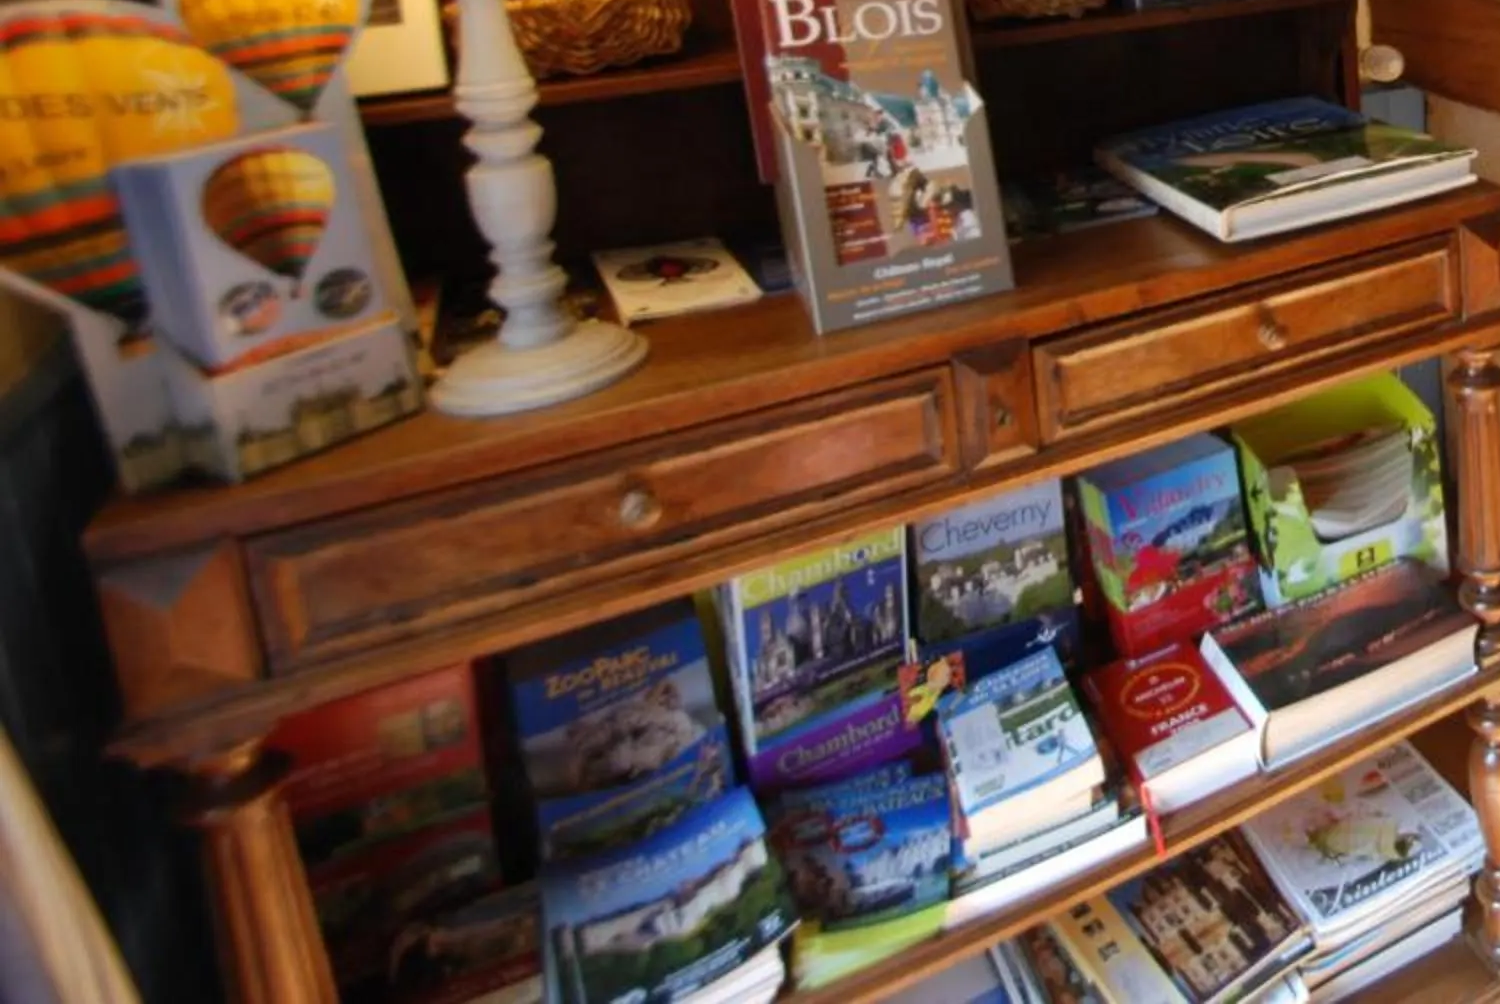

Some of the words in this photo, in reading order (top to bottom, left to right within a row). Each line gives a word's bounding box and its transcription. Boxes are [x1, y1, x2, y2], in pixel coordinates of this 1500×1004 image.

[918, 496, 1053, 556] Cheverny
[741, 525, 901, 604] Chambord
[776, 703, 901, 773] Chambord
[1149, 703, 1209, 737] FRANCE
